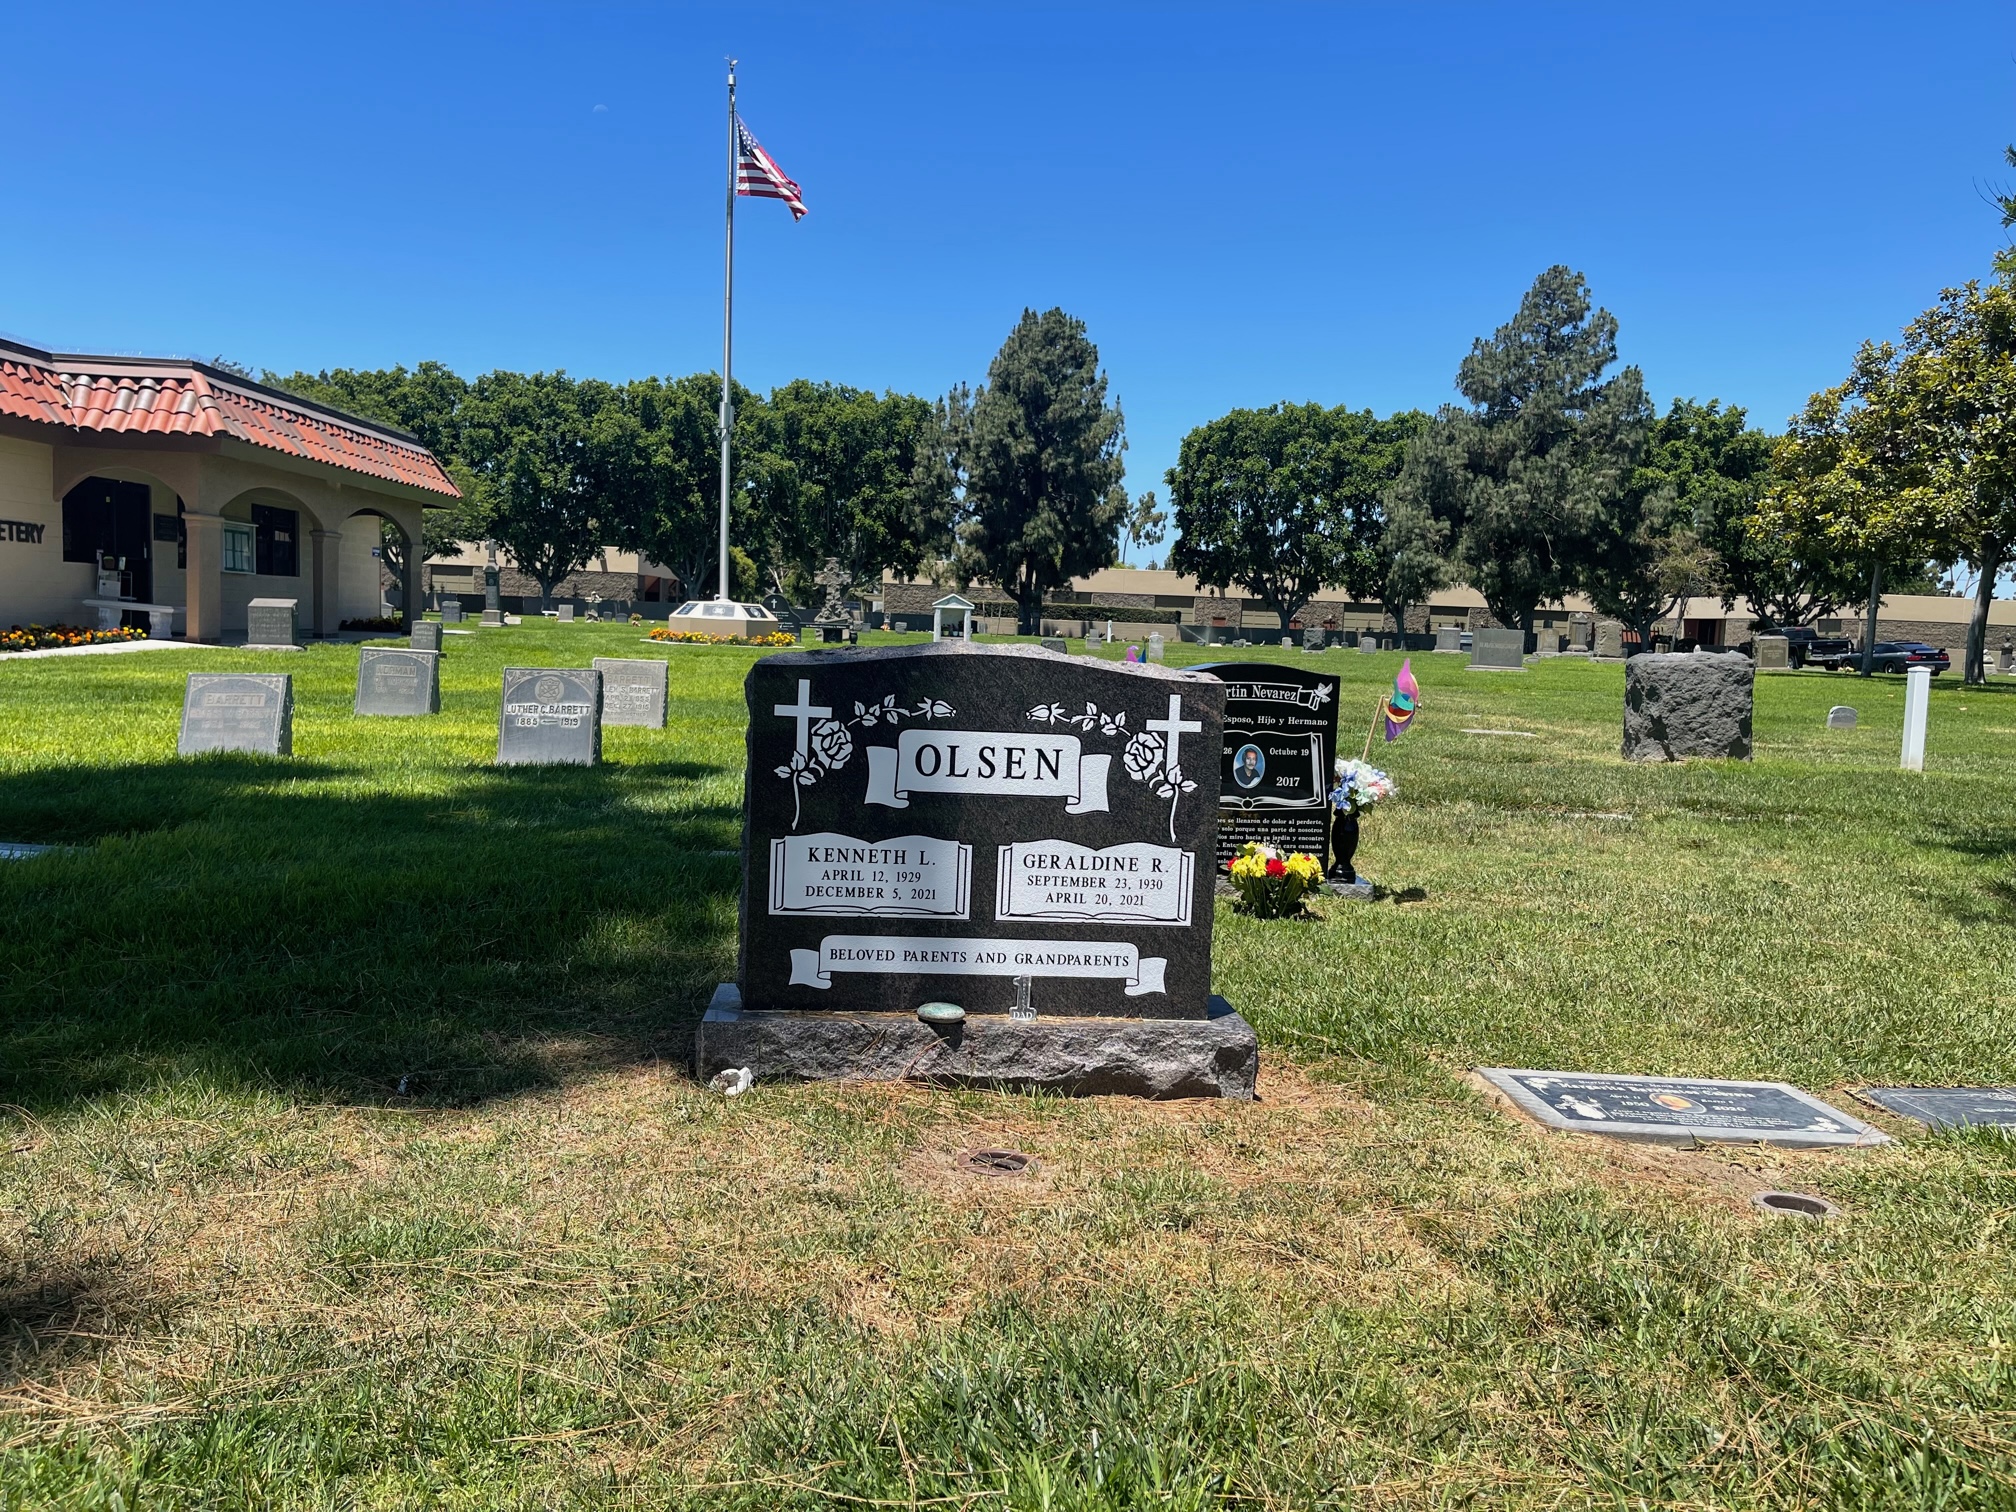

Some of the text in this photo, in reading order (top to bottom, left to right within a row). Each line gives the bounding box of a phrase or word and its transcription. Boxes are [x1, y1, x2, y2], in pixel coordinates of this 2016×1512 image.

[607, 675, 651, 684] BARRETT
[206, 694, 264, 705] BARRETT
[1252, 684, 1297, 701] Nevarez
[506, 704, 539, 714] LUTHER
[549, 704, 591, 715] BARRETT
[1257, 715, 1276, 725] Hijo
[1279, 717, 1284, 725] y
[1288, 716, 1328, 726] Hermano
[1269, 747, 1309, 756] Octubre 19
[914, 743, 1063, 780] OLSEN
[1276, 776, 1300, 787] 2017
[807, 846, 936, 866] KENNETH L.
[1023, 853, 1169, 873] GERALDINE R.
[821, 869, 921, 884] APRIL 12, 1929
[1027, 874, 1163, 890] SEPTEMBER 23, 1930
[805, 885, 936, 901] DECEMBER 5, 2021
[1045, 891, 1144, 906] APRIL 20, 2021
[829, 948, 1130, 968] BELOVED PARENTS AND GRANDPARENTS
[1012, 1011, 1033, 1019] DAD
[1712, 1105, 1747, 1113] 2020
